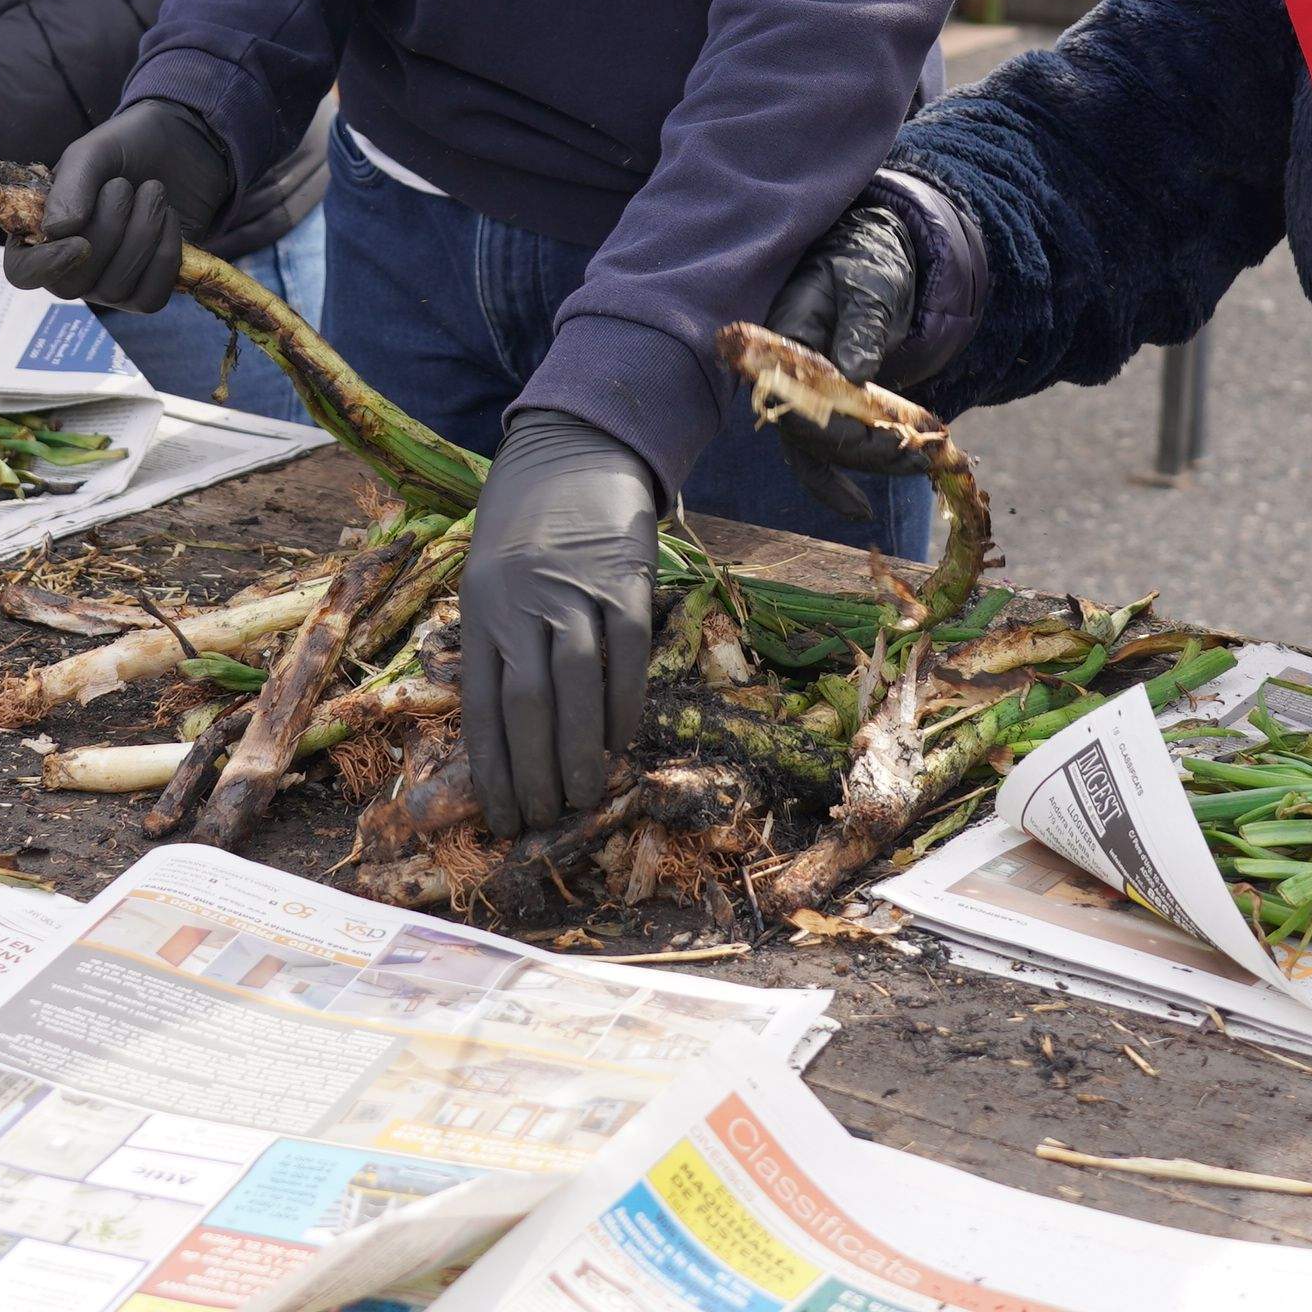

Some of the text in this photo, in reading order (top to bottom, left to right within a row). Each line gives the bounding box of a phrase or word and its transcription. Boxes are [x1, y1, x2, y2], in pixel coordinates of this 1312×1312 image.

[1071, 746, 1127, 827] IMGEST
[1118, 741, 1146, 797] CLASSIFICATS
[1047, 794, 1072, 831] Andorra
[1064, 802, 1098, 854] LLOGUERS
[1127, 829, 1137, 839] C/
[1131, 837, 1143, 854] Pere
[339, 921, 388, 939] CISA
[130, 1163, 196, 1188] Attic
[727, 1116, 923, 1287] Classificats
[667, 1172, 696, 1201] DE
[693, 1199, 785, 1290] FUSTERIA
